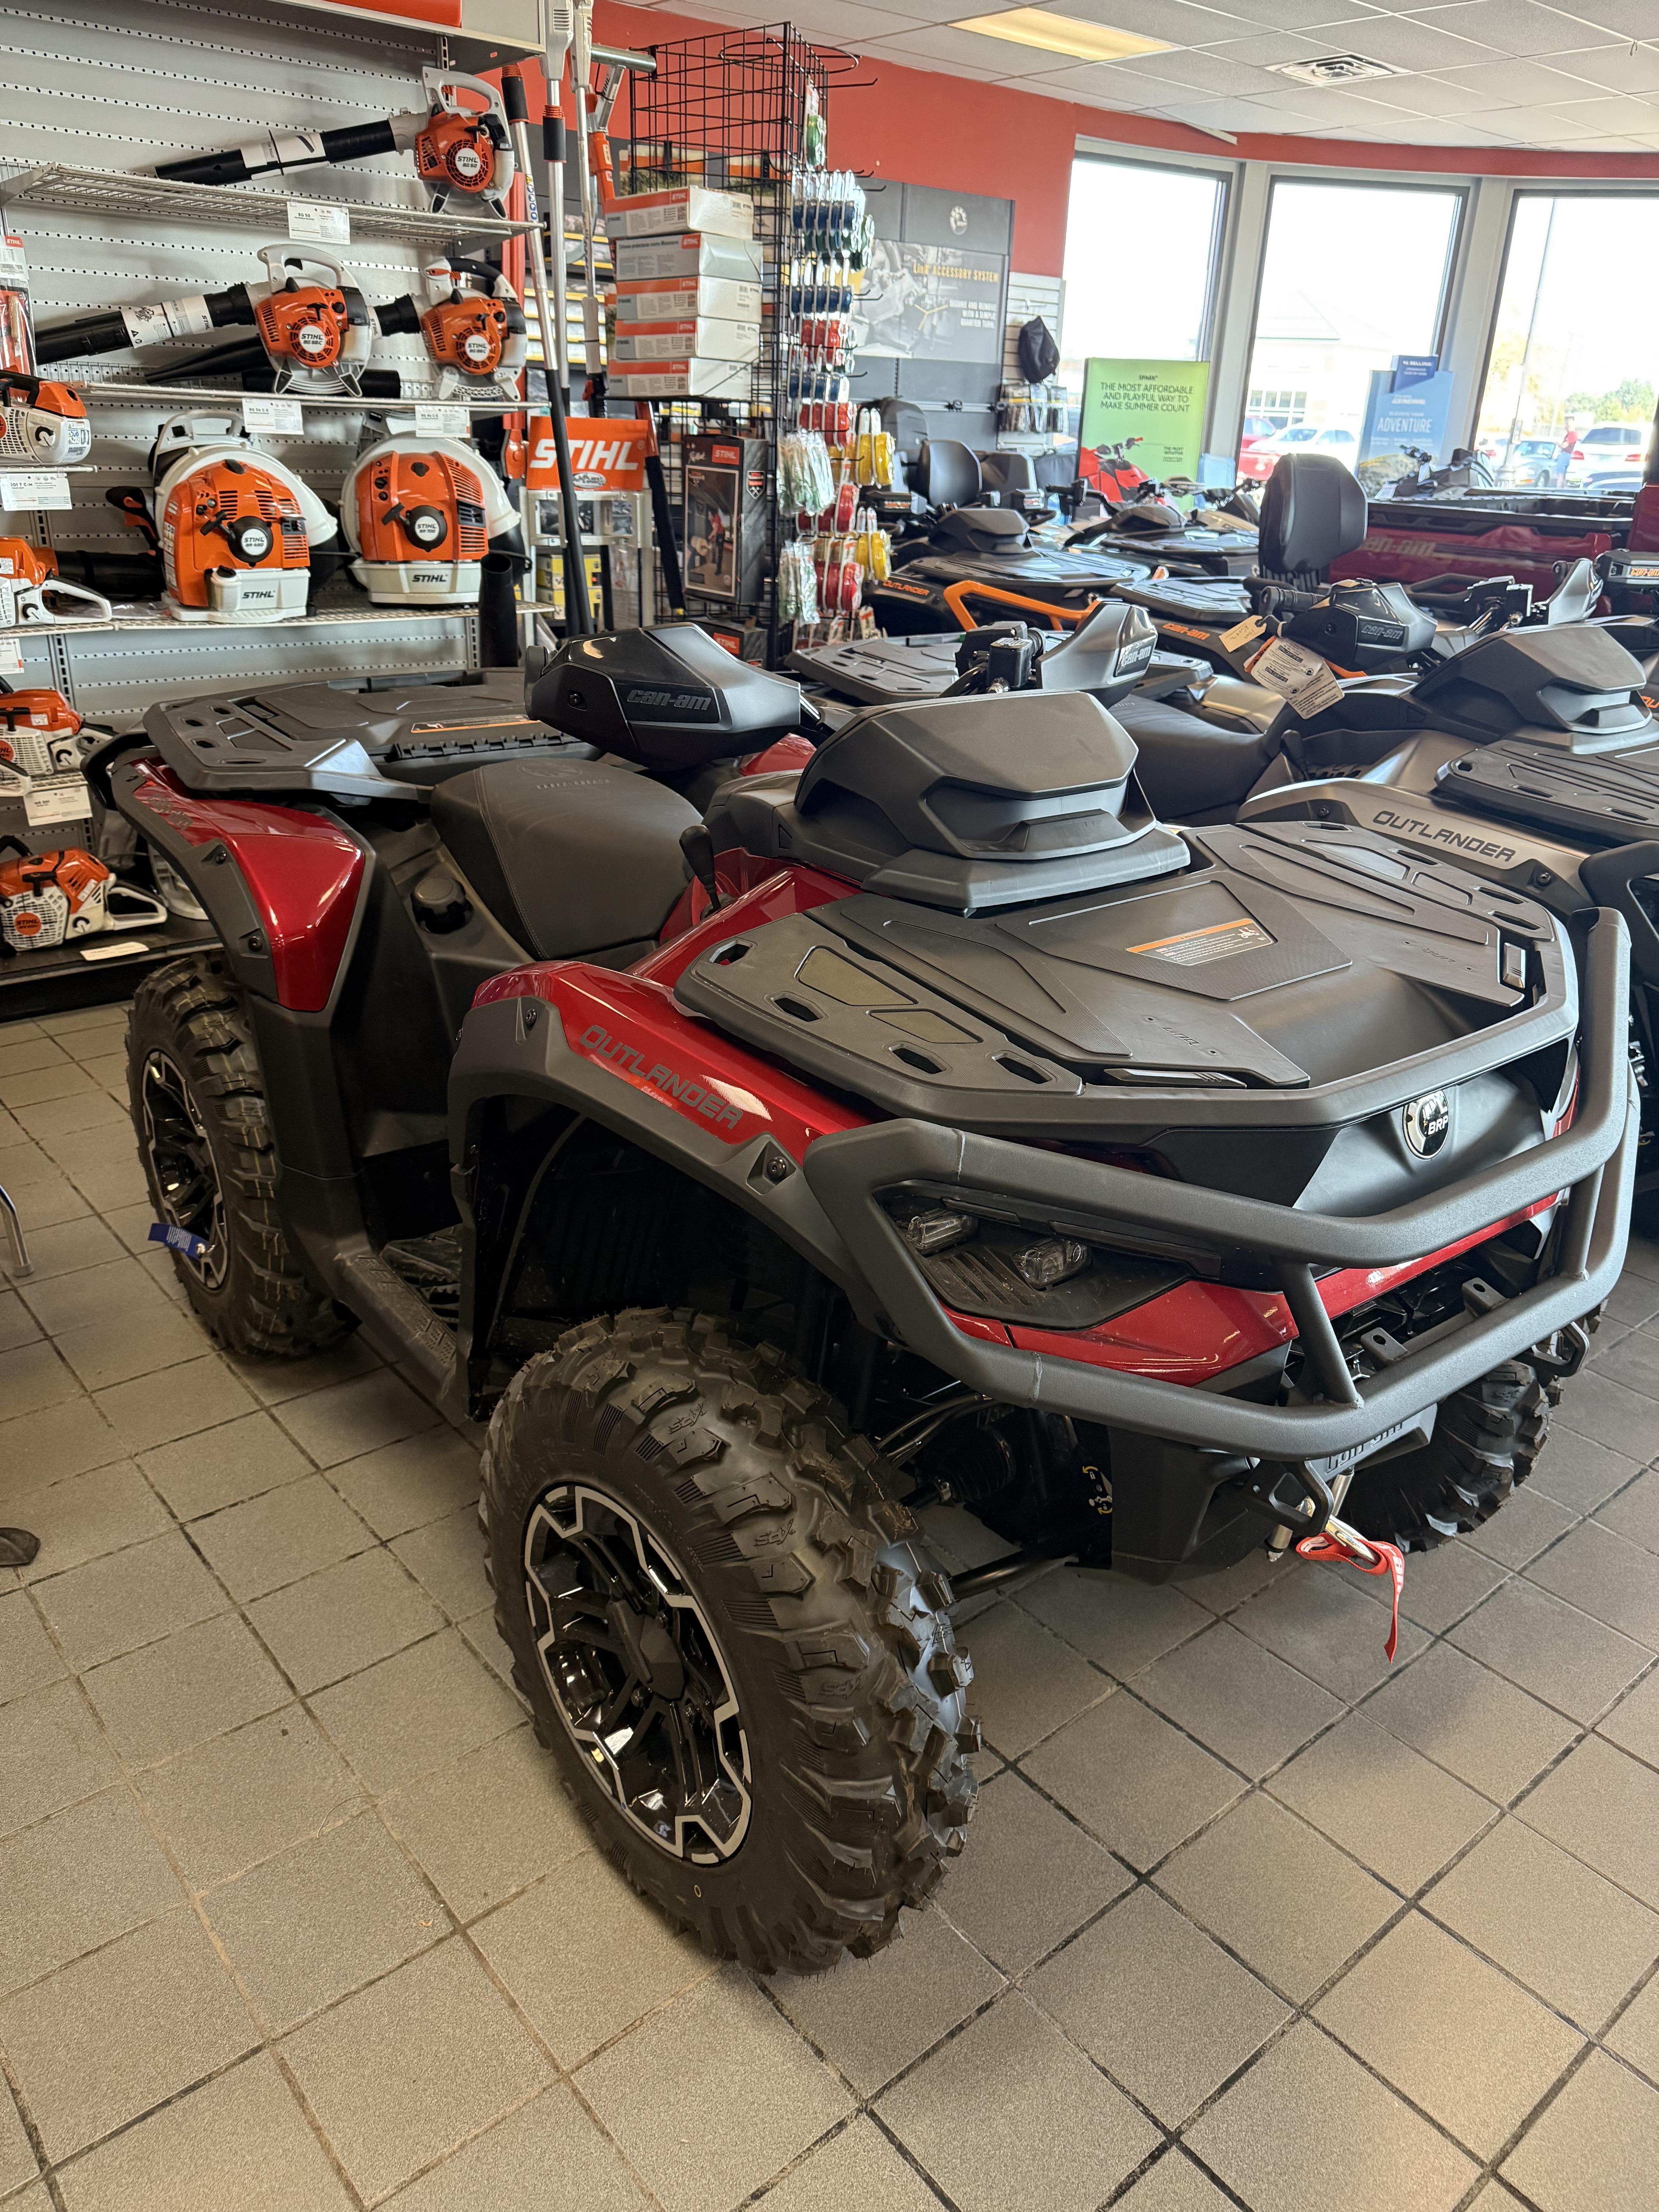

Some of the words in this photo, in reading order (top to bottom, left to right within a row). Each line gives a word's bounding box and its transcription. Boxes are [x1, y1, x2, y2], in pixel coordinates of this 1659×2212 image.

[932, 265, 972, 279] ACCESSORY
[974, 270, 1000, 283] SYSTEM
[202, 315, 210, 330] STIHL
[1101, 382, 1116, 391] THE
[1118, 383, 1142, 392] MOST
[1143, 384, 1194, 394] AFFORDABLE
[1103, 392, 1121, 400] AND
[1123, 393, 1156, 402] PLAYFUL
[1158, 395, 1176, 403] WAY
[1101, 401, 1122, 410] MAKE
[1124, 402, 1159, 411] SUMMER
[1160, 404, 1191, 412] COUNT
[1377, 417, 1432, 433] ADVENTURE
[530, 439, 638, 470] STIHL
[715, 450, 737, 459] STIHL
[1360, 536, 1436, 556] an-am
[883, 580, 929, 596] OUTLANDER
[1163, 623, 1210, 640] can-am
[1361, 624, 1403, 639] can-am
[1121, 646, 1151, 667] can-am
[627, 689, 711, 710] can-am
[1372, 811, 1516, 862] OUTLANDER
[579, 1025, 743, 1129] OUTLANDER
[1428, 1115, 1448, 1135] BRP
